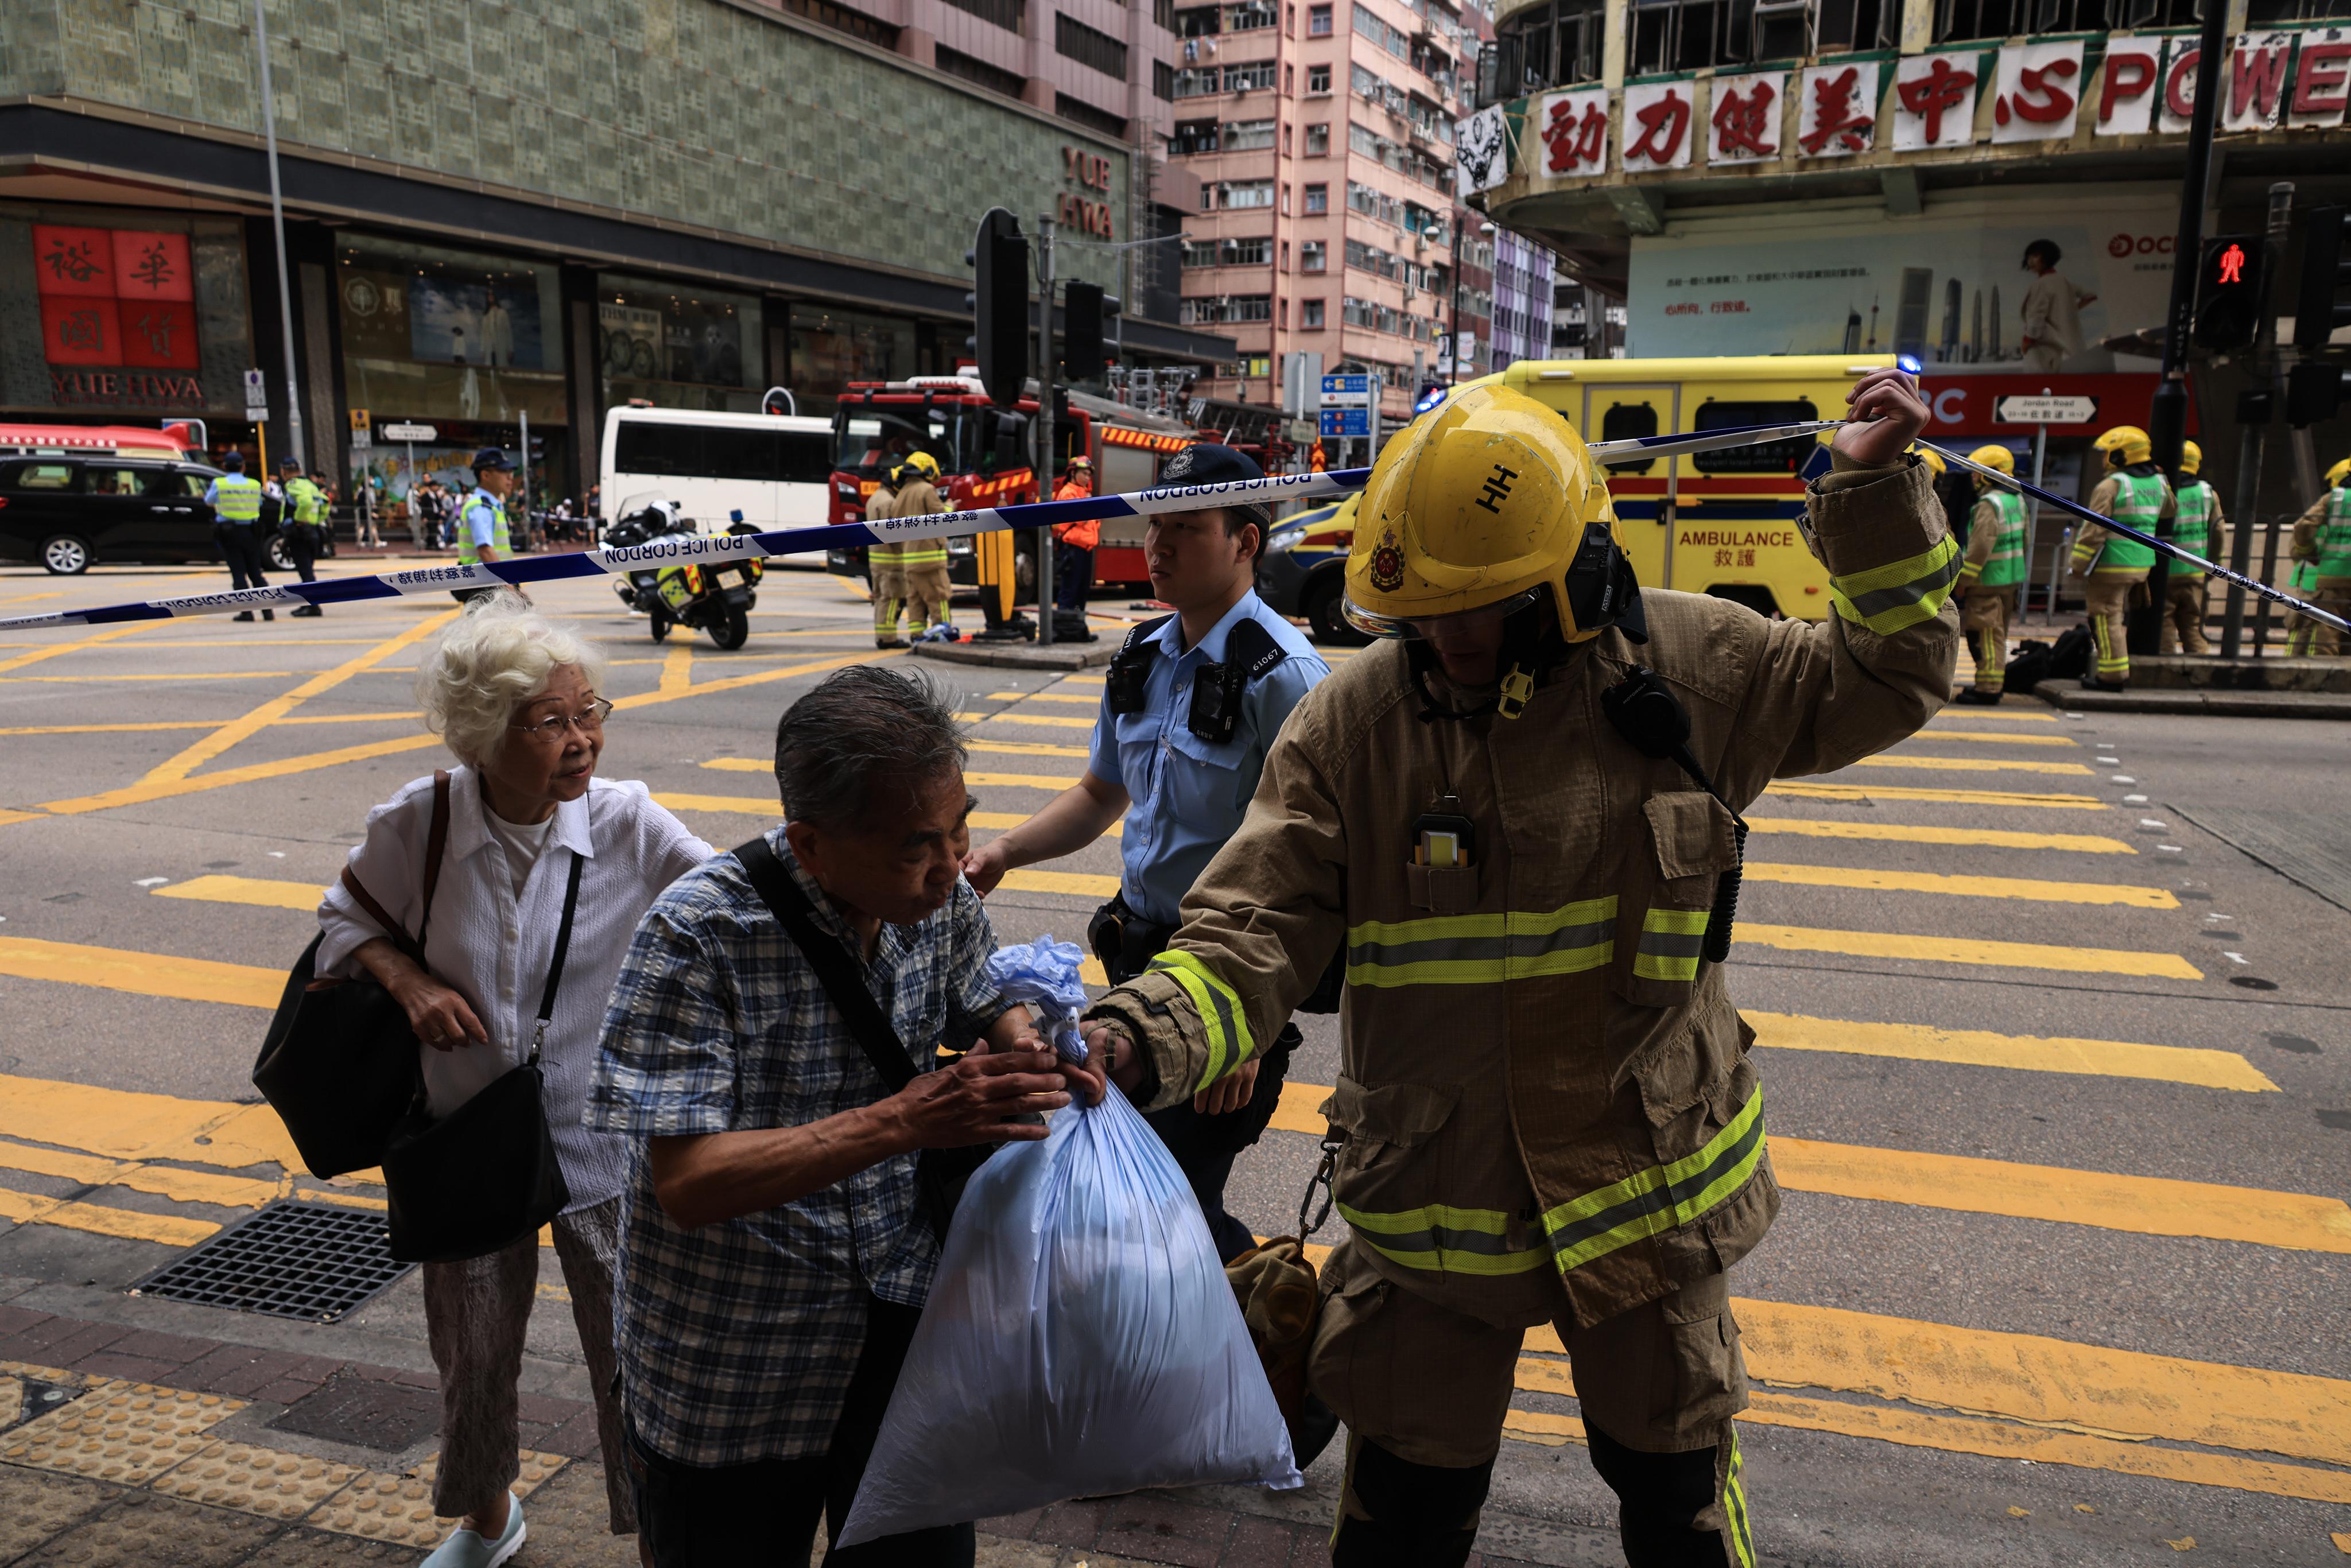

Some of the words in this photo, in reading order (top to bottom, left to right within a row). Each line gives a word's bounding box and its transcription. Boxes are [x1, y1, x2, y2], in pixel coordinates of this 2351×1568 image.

[1061, 145, 1111, 192] YUE
[1057, 191, 1114, 238] HWA
[44, 239, 174, 291] 裕華
[60, 309, 181, 359] 國貨
[50, 371, 118, 396] YUE
[127, 375, 203, 398] HWA
[2022, 399, 2051, 407] Jordan
[2053, 399, 2075, 407] Road
[1253, 503, 1267, 518] POLICE
[681, 536, 744, 556] POLICE
[1679, 531, 1794, 547] AMBULANCE
[1713, 549, 1756, 567] 救護
[1252, 648, 1279, 671] 61067
[1623, 682, 1647, 704] MOTOROLA
